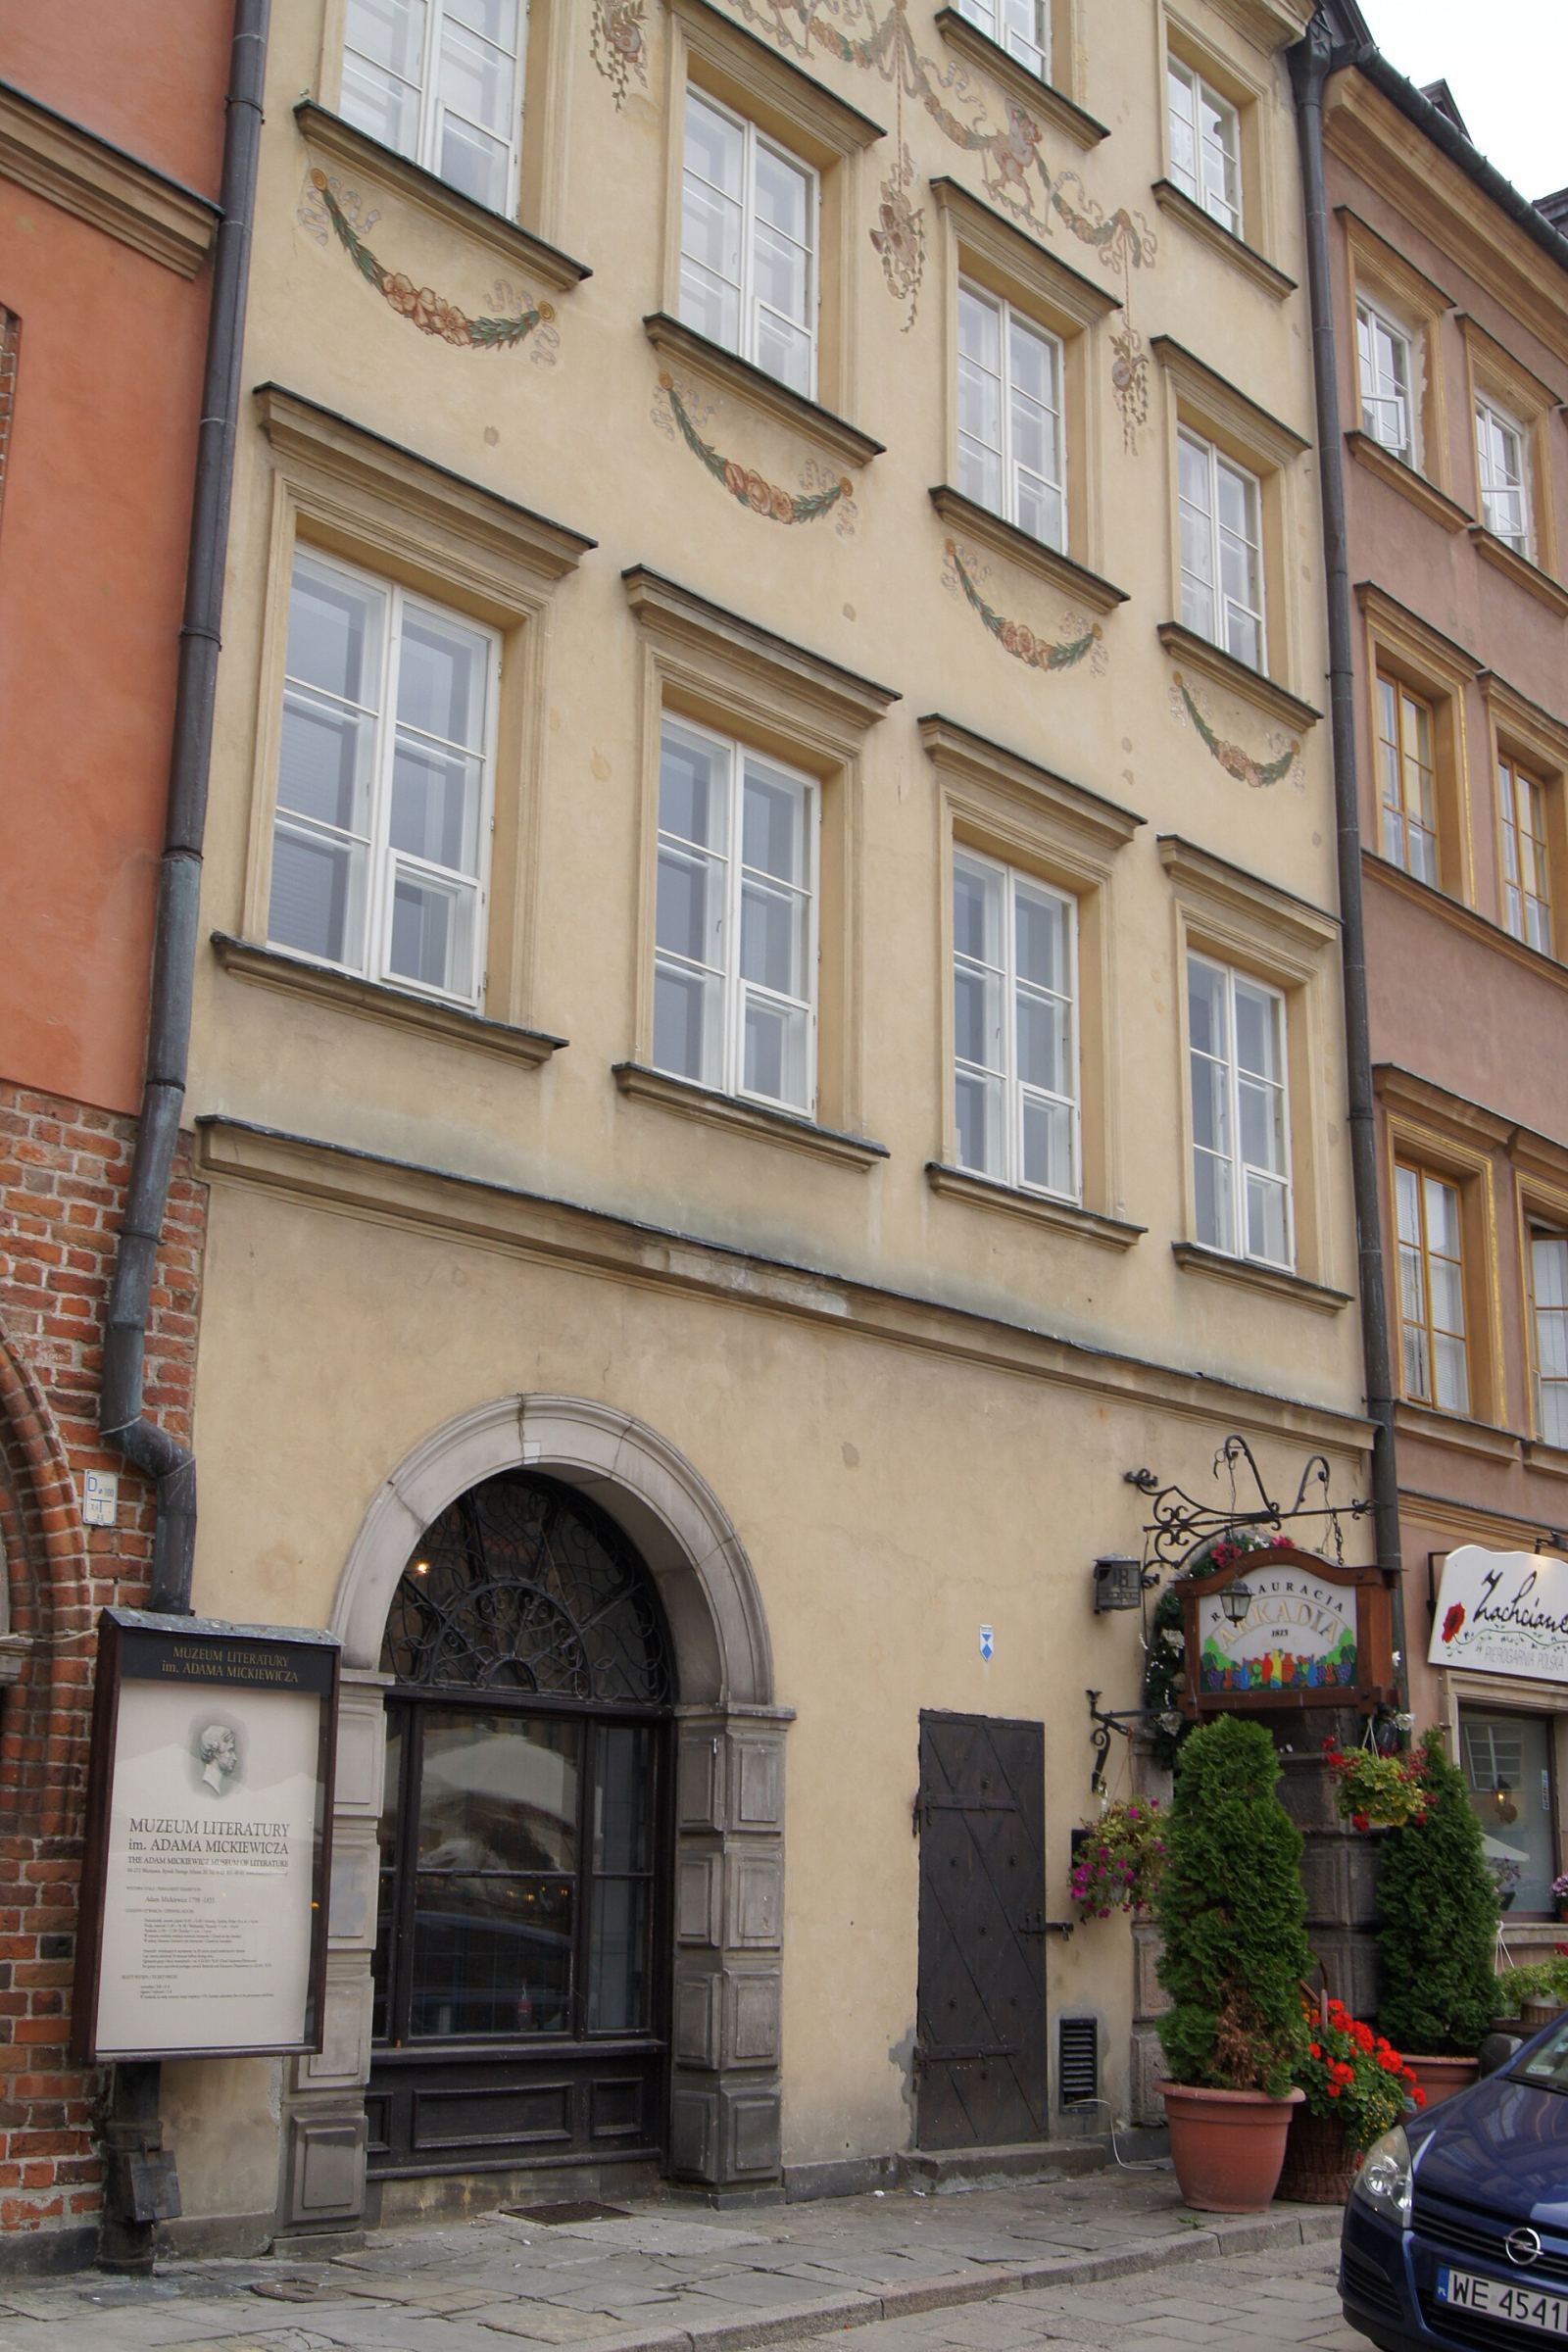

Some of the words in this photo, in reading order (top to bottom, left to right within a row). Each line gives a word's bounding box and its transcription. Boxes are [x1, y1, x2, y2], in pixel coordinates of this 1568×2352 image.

[1210, 1581, 1344, 1622] RAURACJA
[1218, 1597, 1339, 1649] ARKADIA
[173, 1645, 222, 1663] MUZEUM
[227, 1650, 290, 1667] LITERATURY
[162, 1660, 179, 1673] im.
[183, 1663, 223, 1677] ADAMA
[226, 1666, 299, 1683] MICKIEWICZA
[129, 1818, 199, 1835] MUZEUM
[203, 1821, 290, 1838] LITERATURY
[128, 1838, 147, 1850] im.
[150, 1839, 203, 1852] ADAMA
[205, 1840, 289, 1855] MICKIEWICZA
[144, 1856, 166, 1865] ADAM
[1453, 2274, 1489, 2310] WE
[1498, 2288, 1568, 2332] 4541
